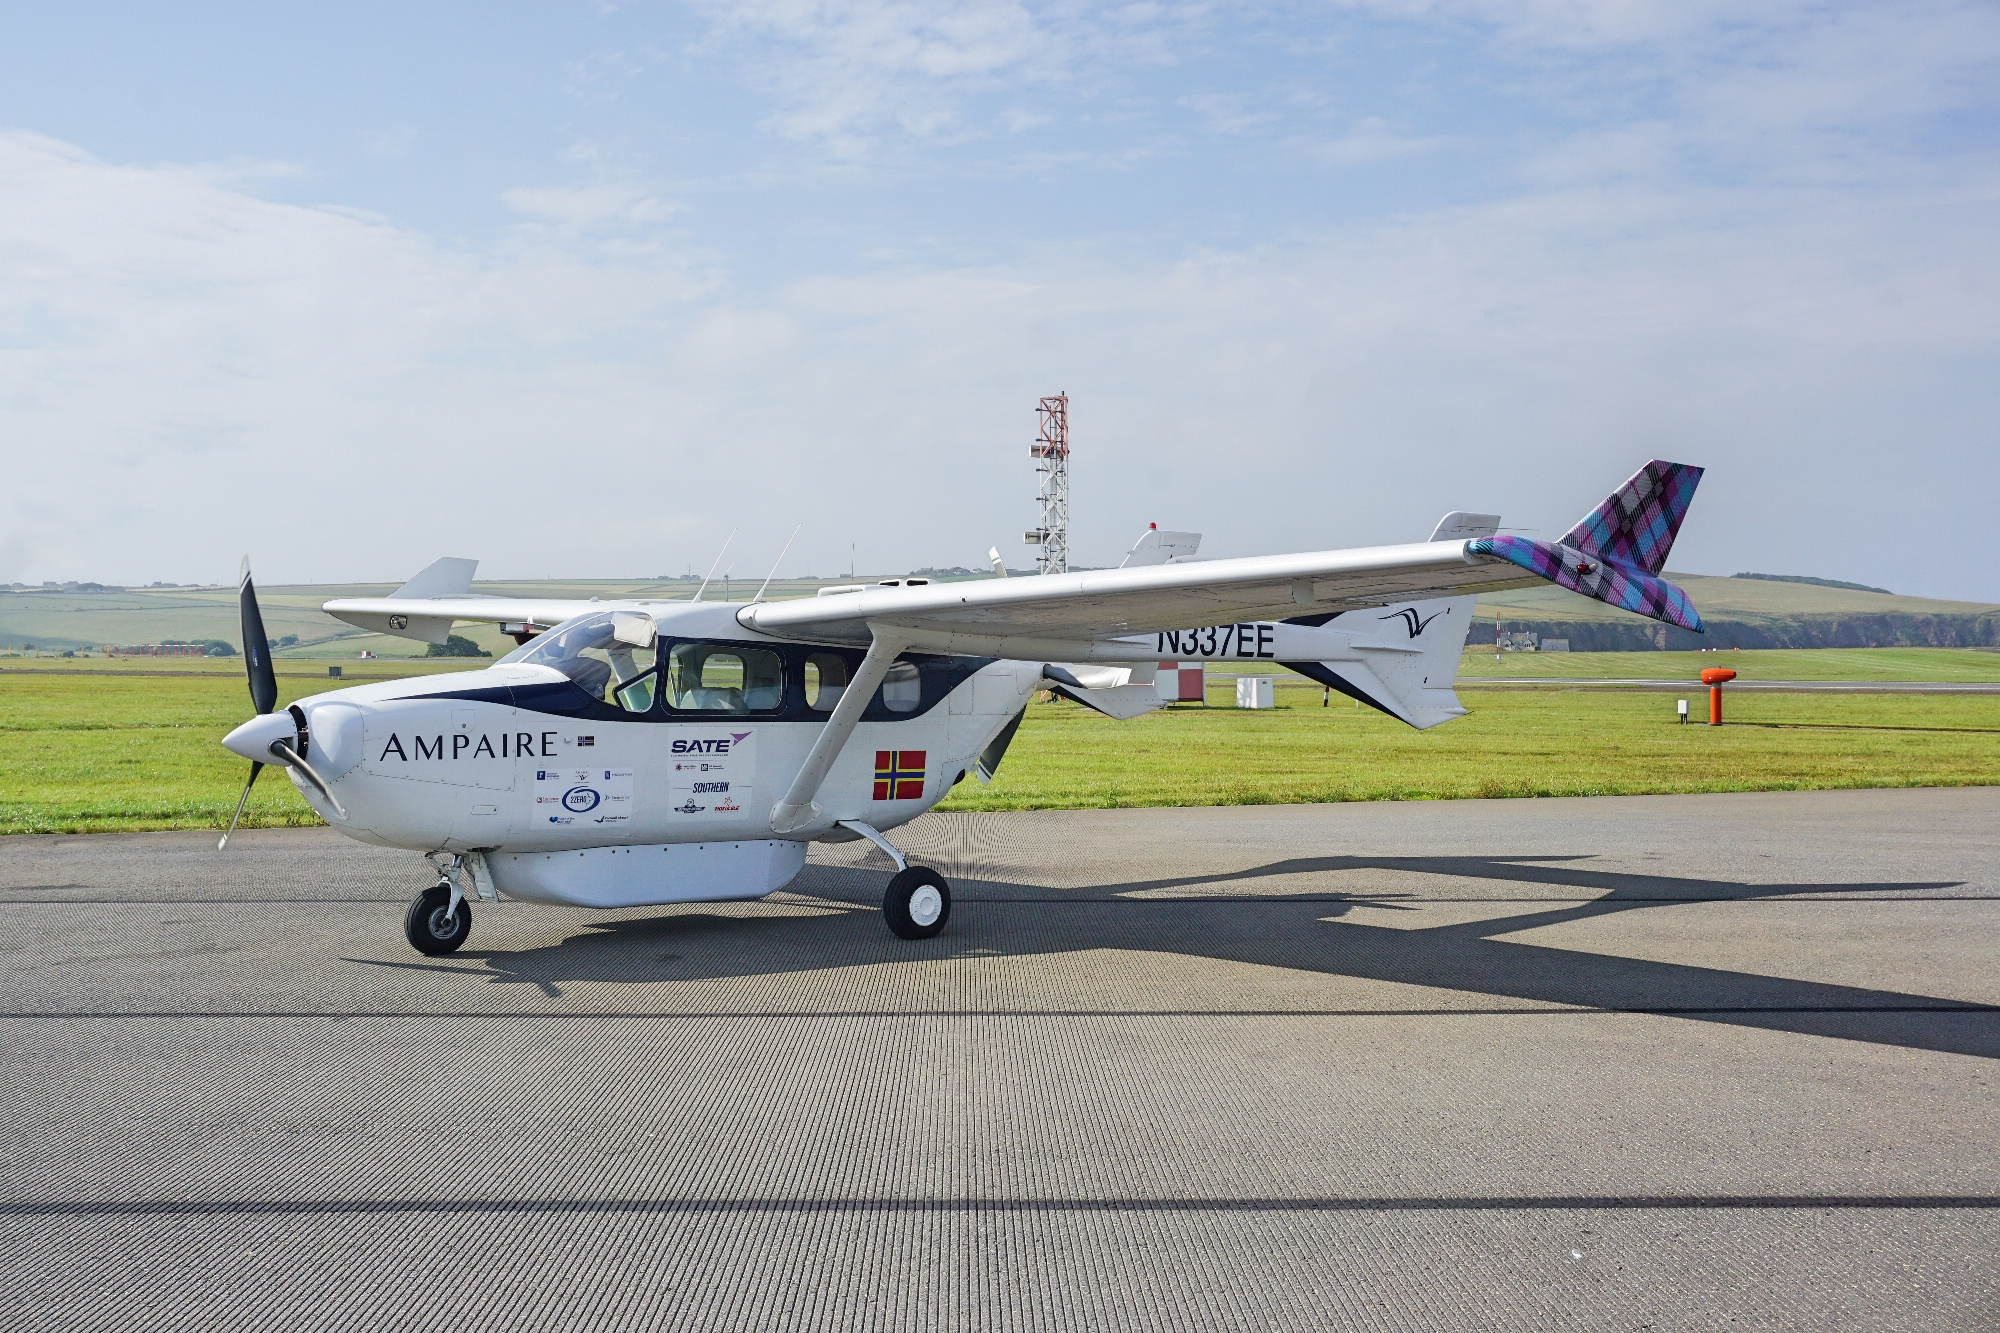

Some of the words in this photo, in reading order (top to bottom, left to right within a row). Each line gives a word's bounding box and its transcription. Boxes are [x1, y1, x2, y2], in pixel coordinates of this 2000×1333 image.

[1158, 624, 1274, 658] N337EE
[380, 732, 558, 761] AMPAIRE
[671, 740, 731, 753] SATE
[693, 782, 730, 793] SOUTHERN
